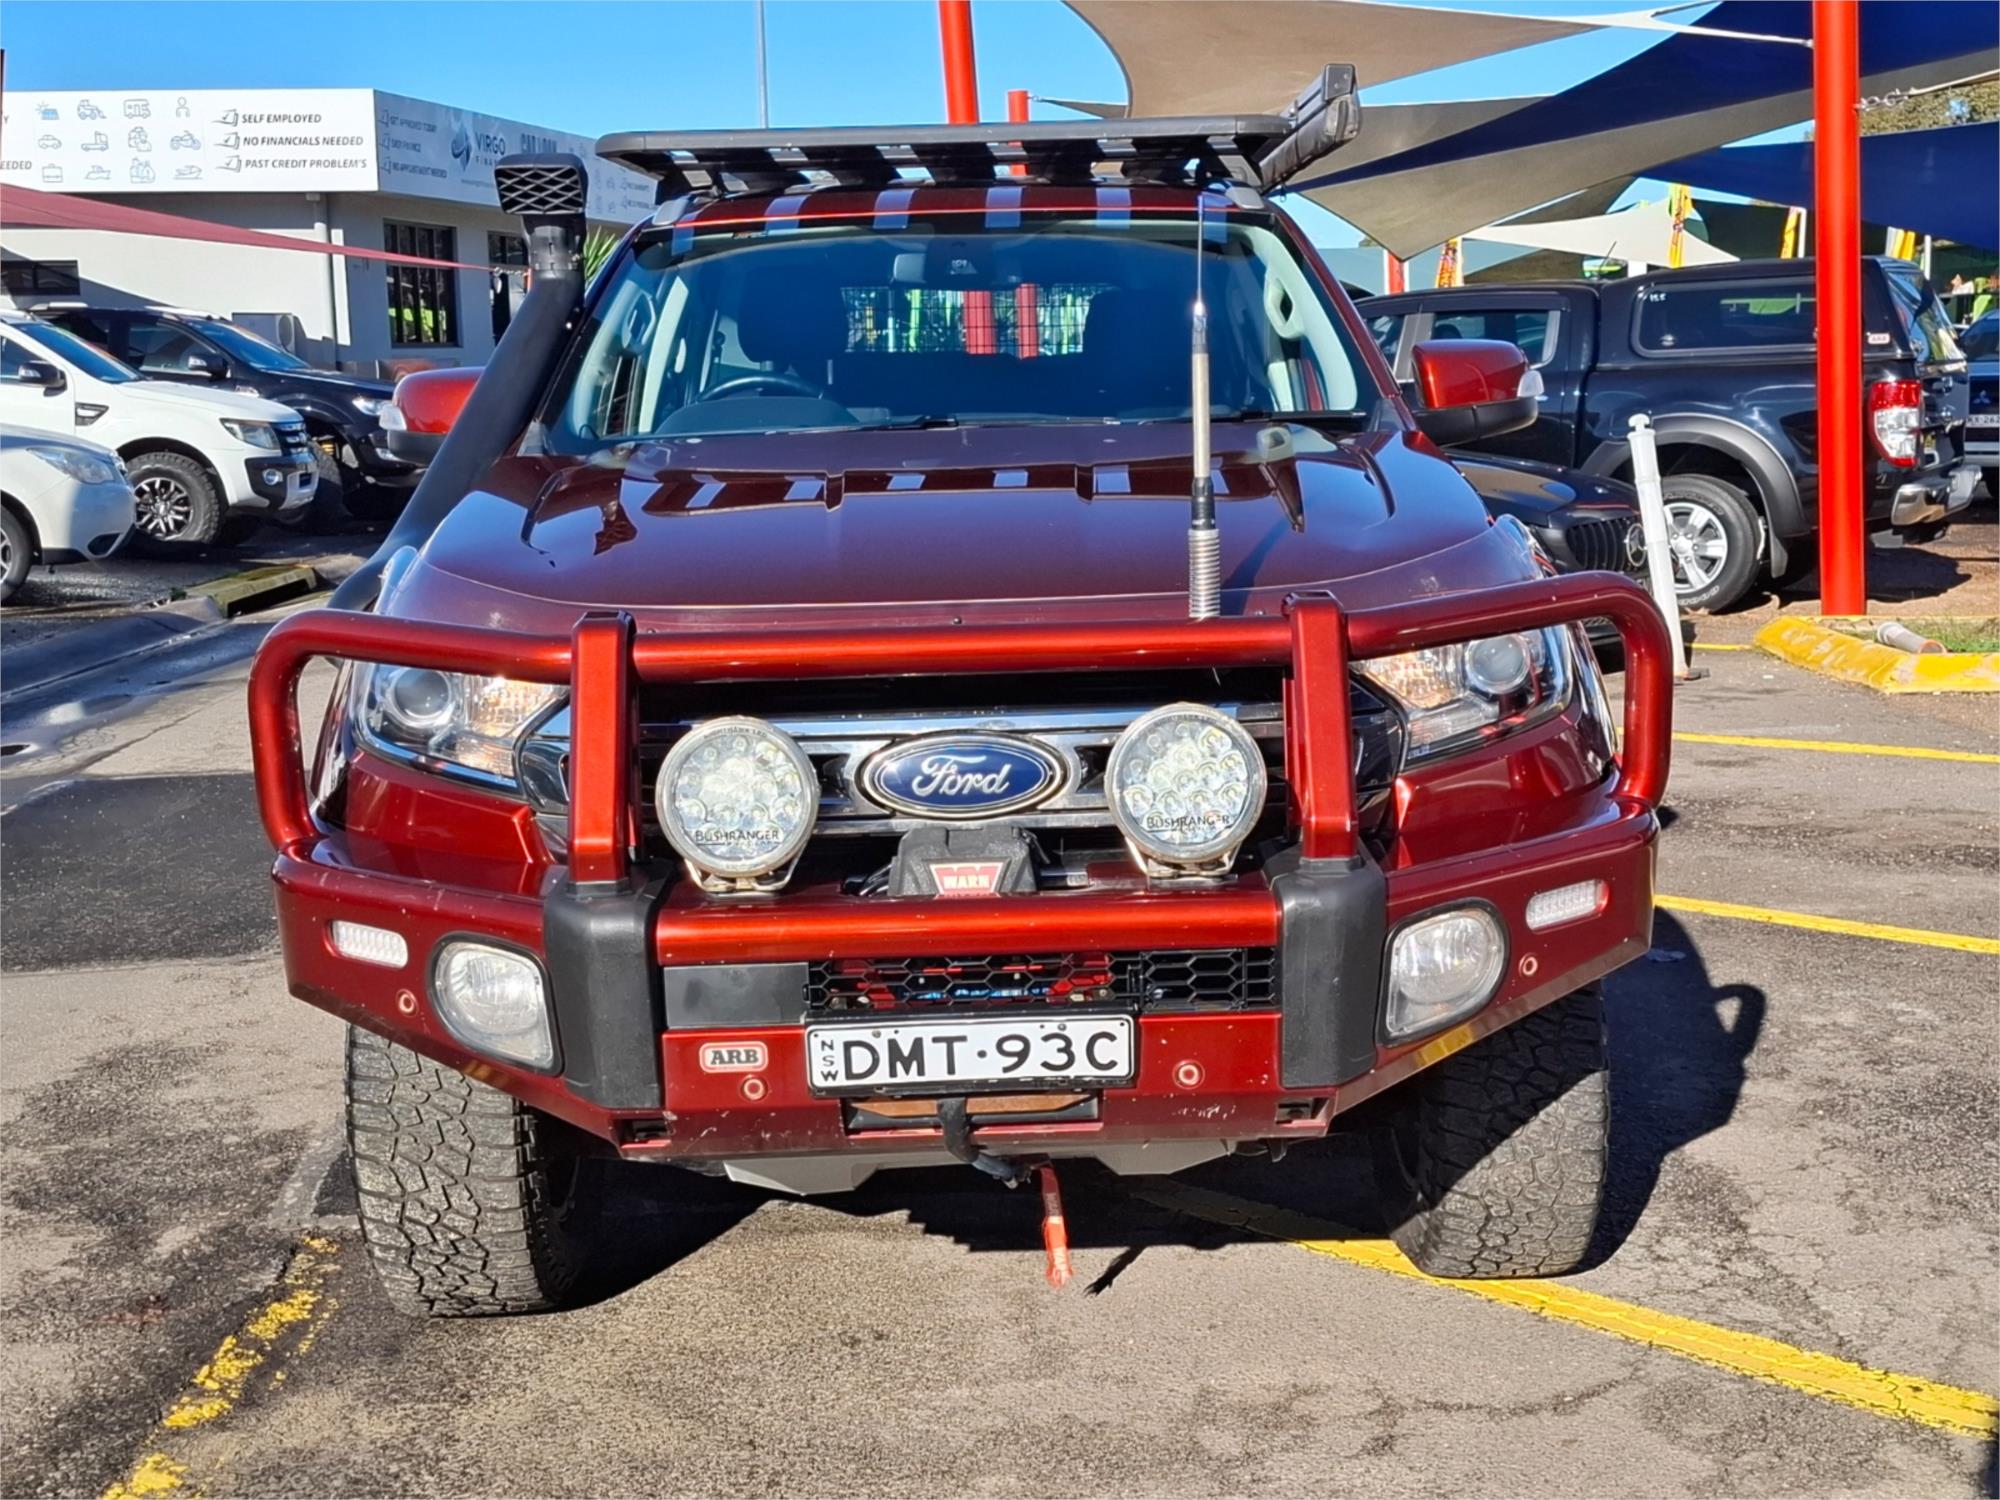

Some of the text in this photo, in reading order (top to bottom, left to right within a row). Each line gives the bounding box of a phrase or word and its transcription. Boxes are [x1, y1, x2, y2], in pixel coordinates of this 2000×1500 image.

[241, 113, 322, 124] SELF EMPLOYED
[243, 136, 364, 146] NO FINANCIALS NEEDED
[475, 131, 506, 156] VIRGO
[245, 158, 367, 169] PAST CREDIT PROBLEM'S
[912, 754, 1012, 797] Ford
[695, 829, 780, 842] BUSHRANGER
[943, 875, 990, 889] WARN
[710, 1048, 759, 1066] ARB
